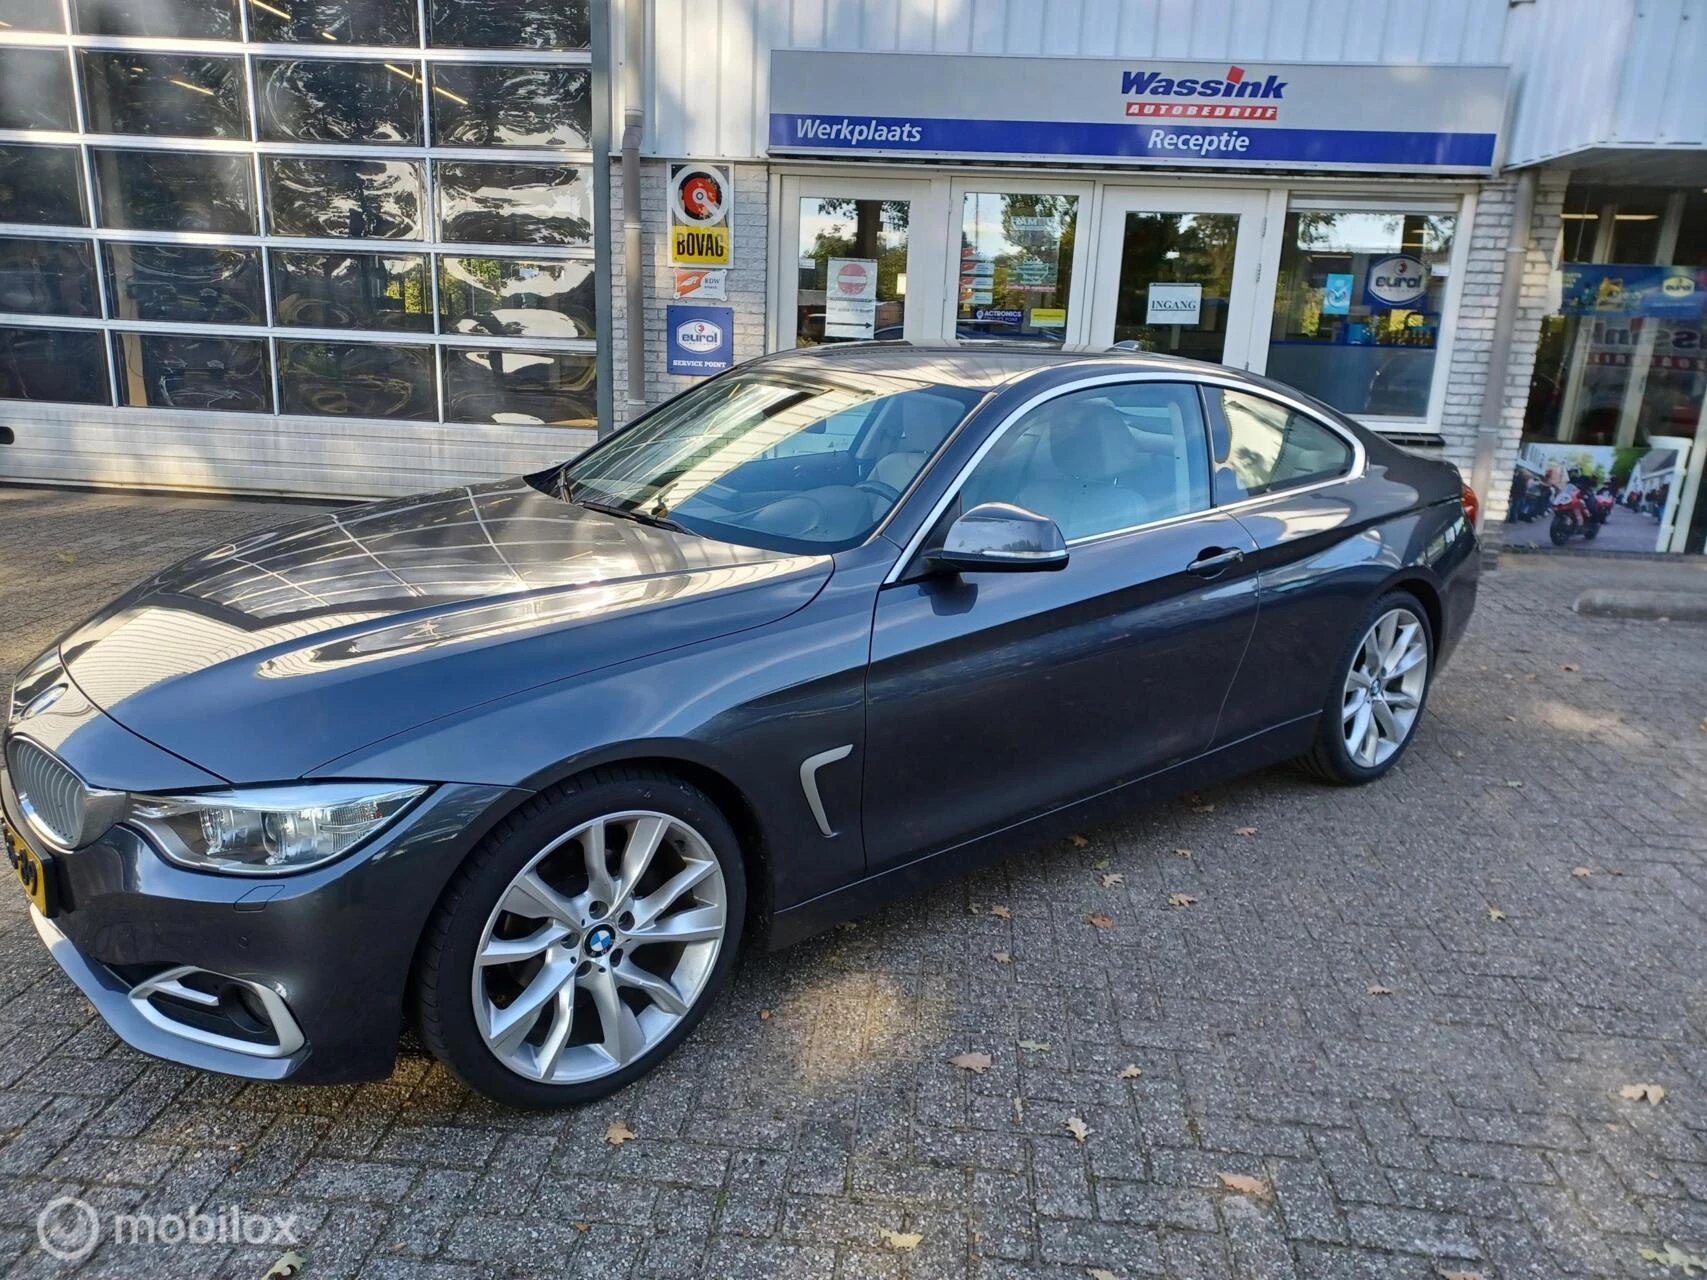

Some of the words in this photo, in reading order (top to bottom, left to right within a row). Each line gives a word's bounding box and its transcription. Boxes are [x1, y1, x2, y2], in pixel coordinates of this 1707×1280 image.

[1121, 66, 1288, 99] Wassink
[1127, 103, 1277, 119] AUTOBEDRIJF
[796, 118, 922, 145] Werkplaats
[1147, 129, 1250, 156] Receptie
[676, 232, 724, 257] BOVAG
[1375, 275, 1423, 289] eurol
[1151, 300, 1196, 309] INGANG
[681, 332, 718, 343] eurol
[672, 359, 704, 367] SERVICE
[704, 360, 727, 368] POINT
